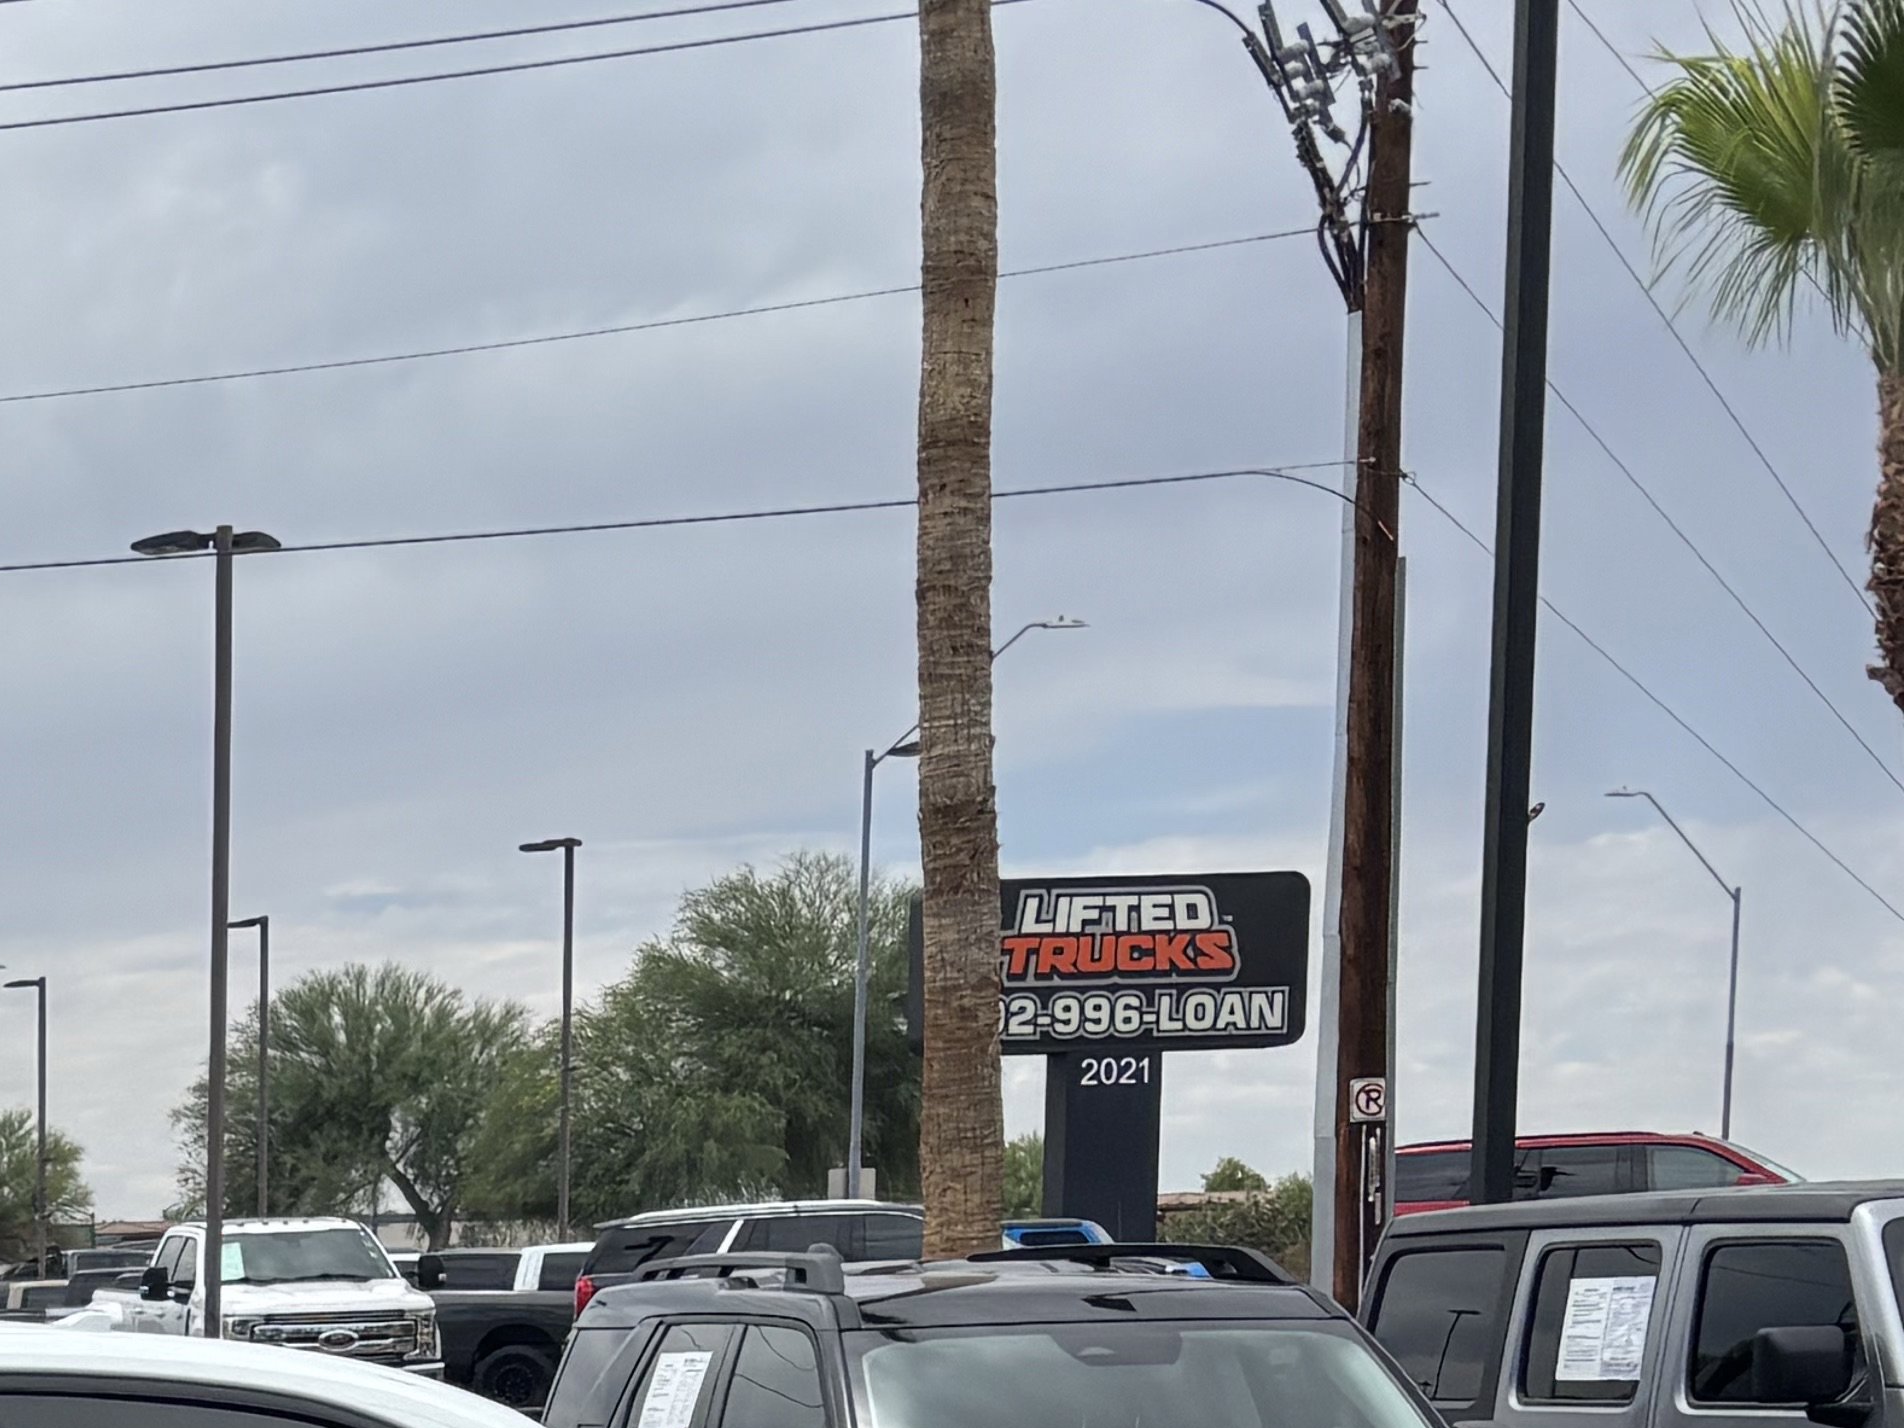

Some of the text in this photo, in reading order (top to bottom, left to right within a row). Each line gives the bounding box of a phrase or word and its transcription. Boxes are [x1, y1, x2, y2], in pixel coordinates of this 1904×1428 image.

[1020, 892, 1213, 935] LIFTED
[1002, 931, 1235, 975] TRUCKS
[1080, 1056, 1150, 1086] 2021
